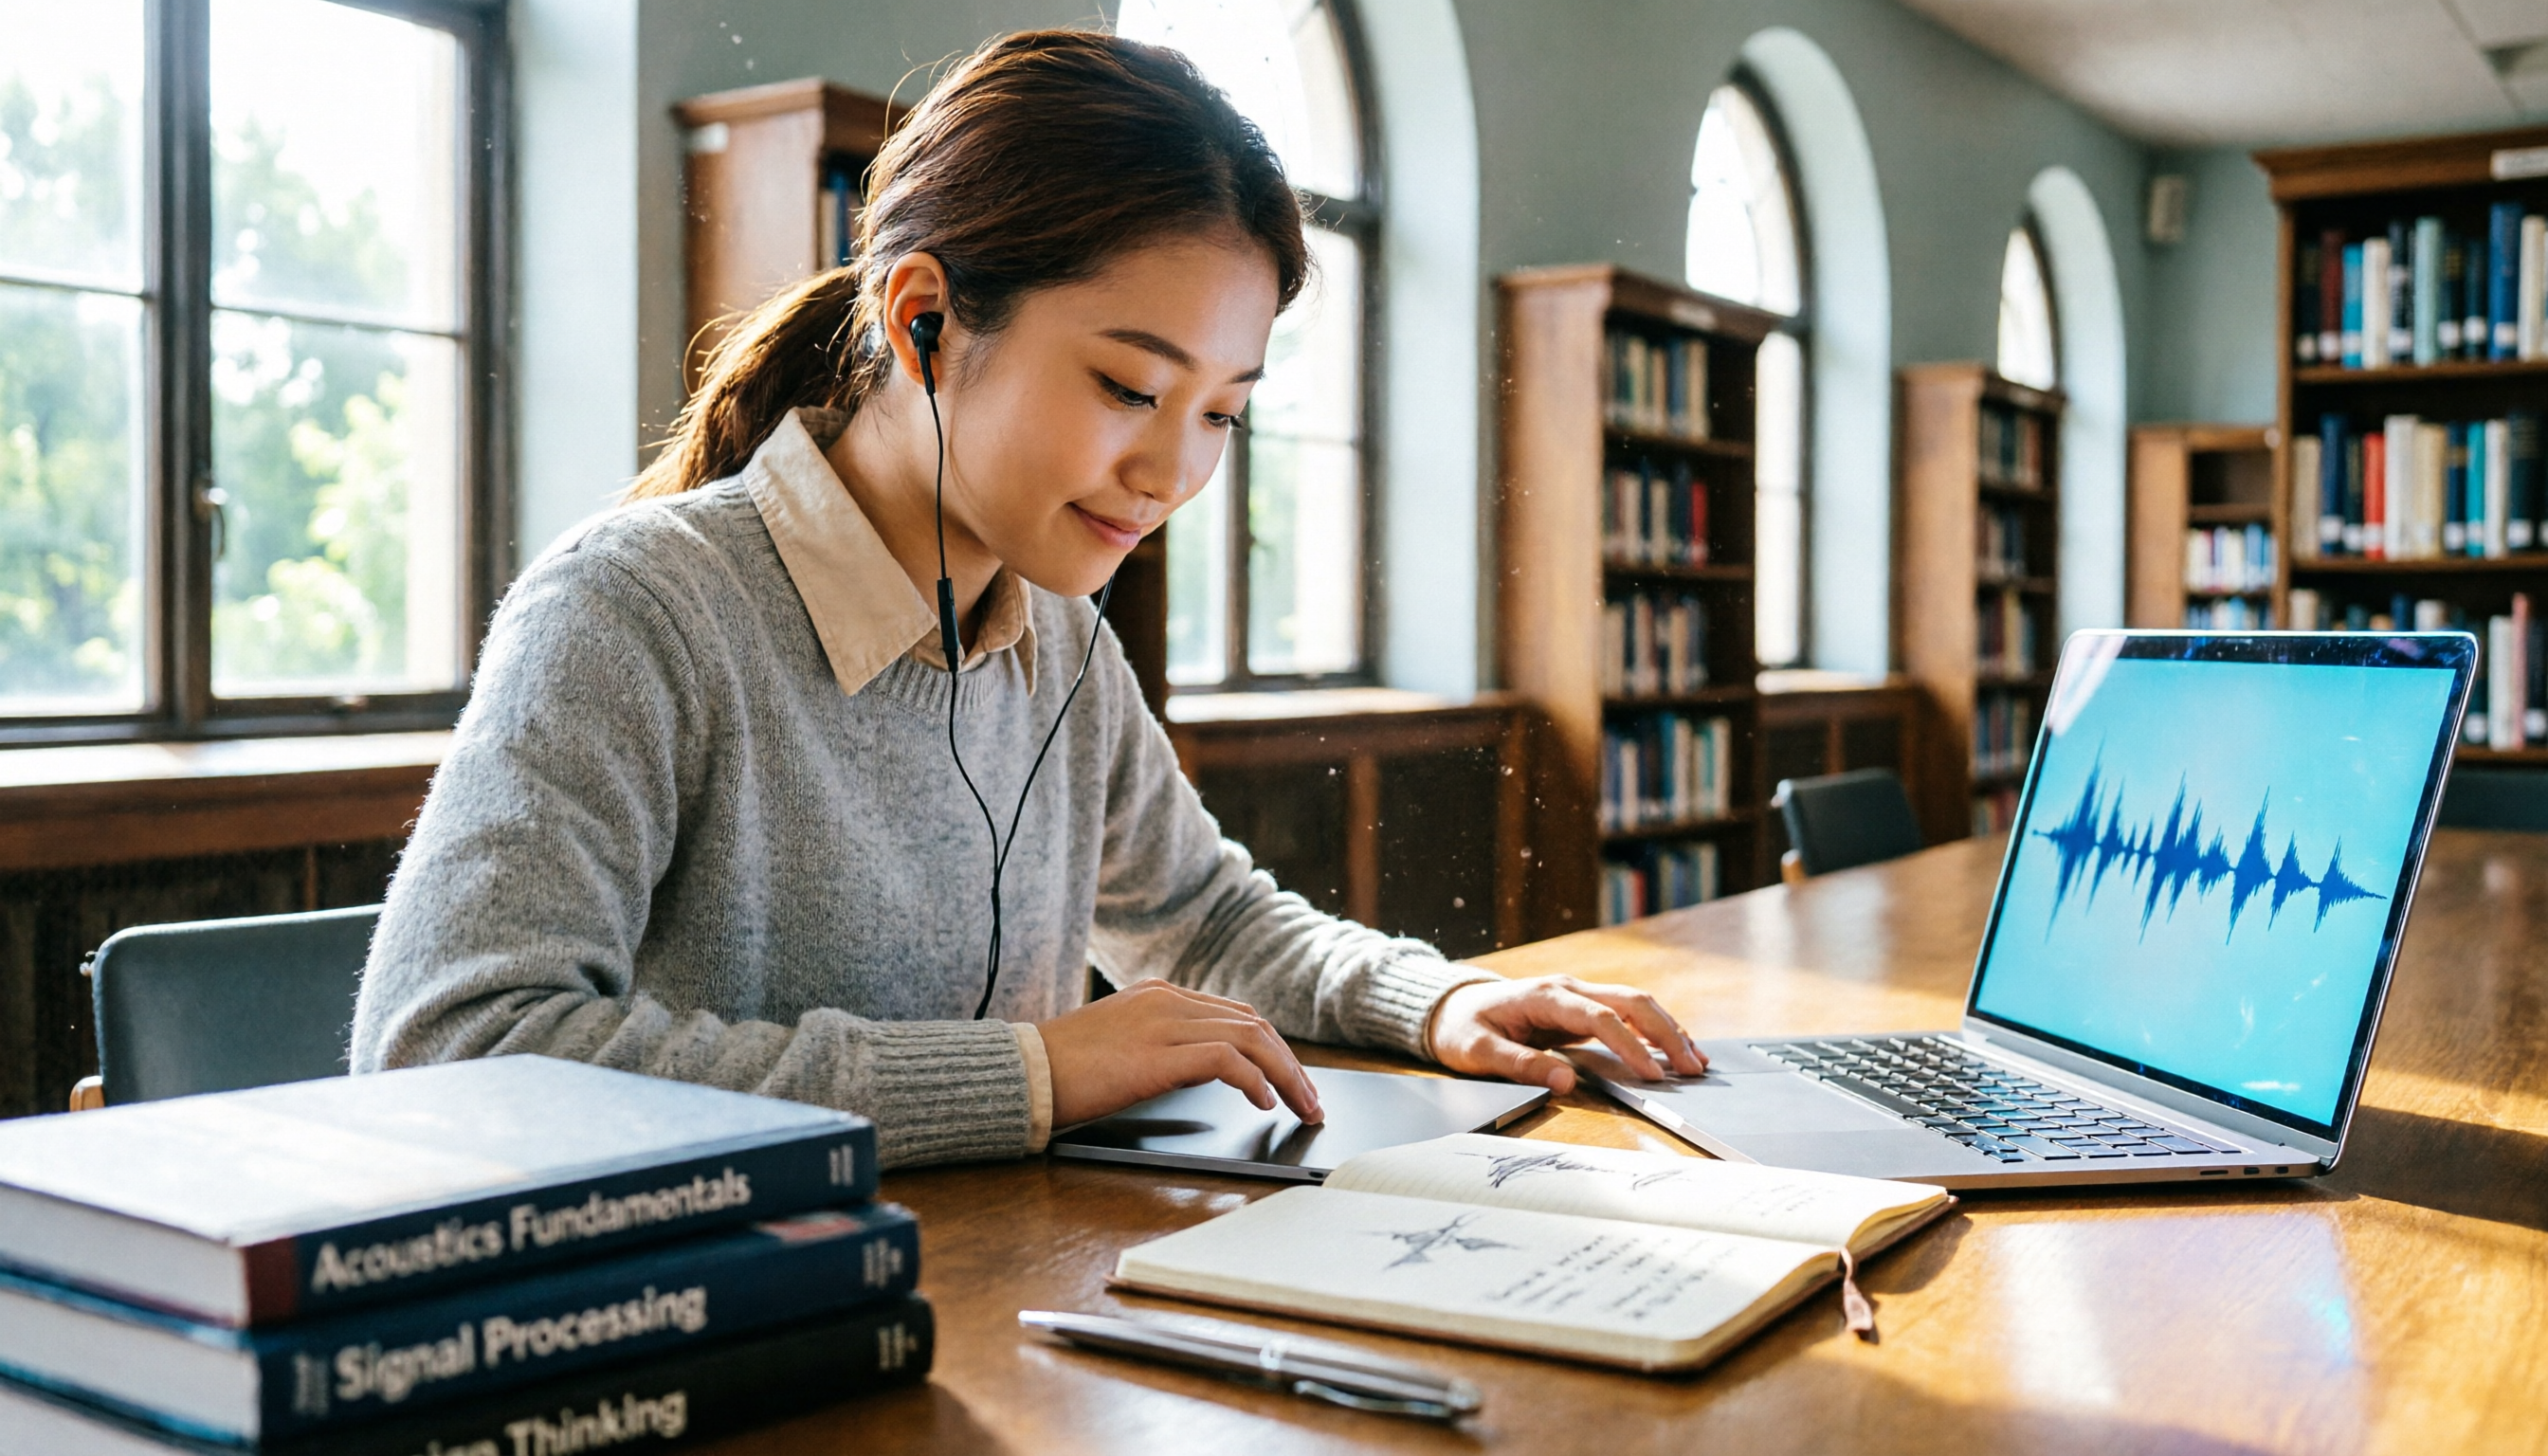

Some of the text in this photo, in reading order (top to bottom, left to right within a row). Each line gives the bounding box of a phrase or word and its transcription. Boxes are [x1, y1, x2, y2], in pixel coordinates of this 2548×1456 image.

[311, 1166, 753, 1293] Acoustics Fundamentals
[335, 1321, 476, 1403] Signal
[483, 1285, 708, 1367] Processing
[504, 1390, 688, 1456] Thinking
